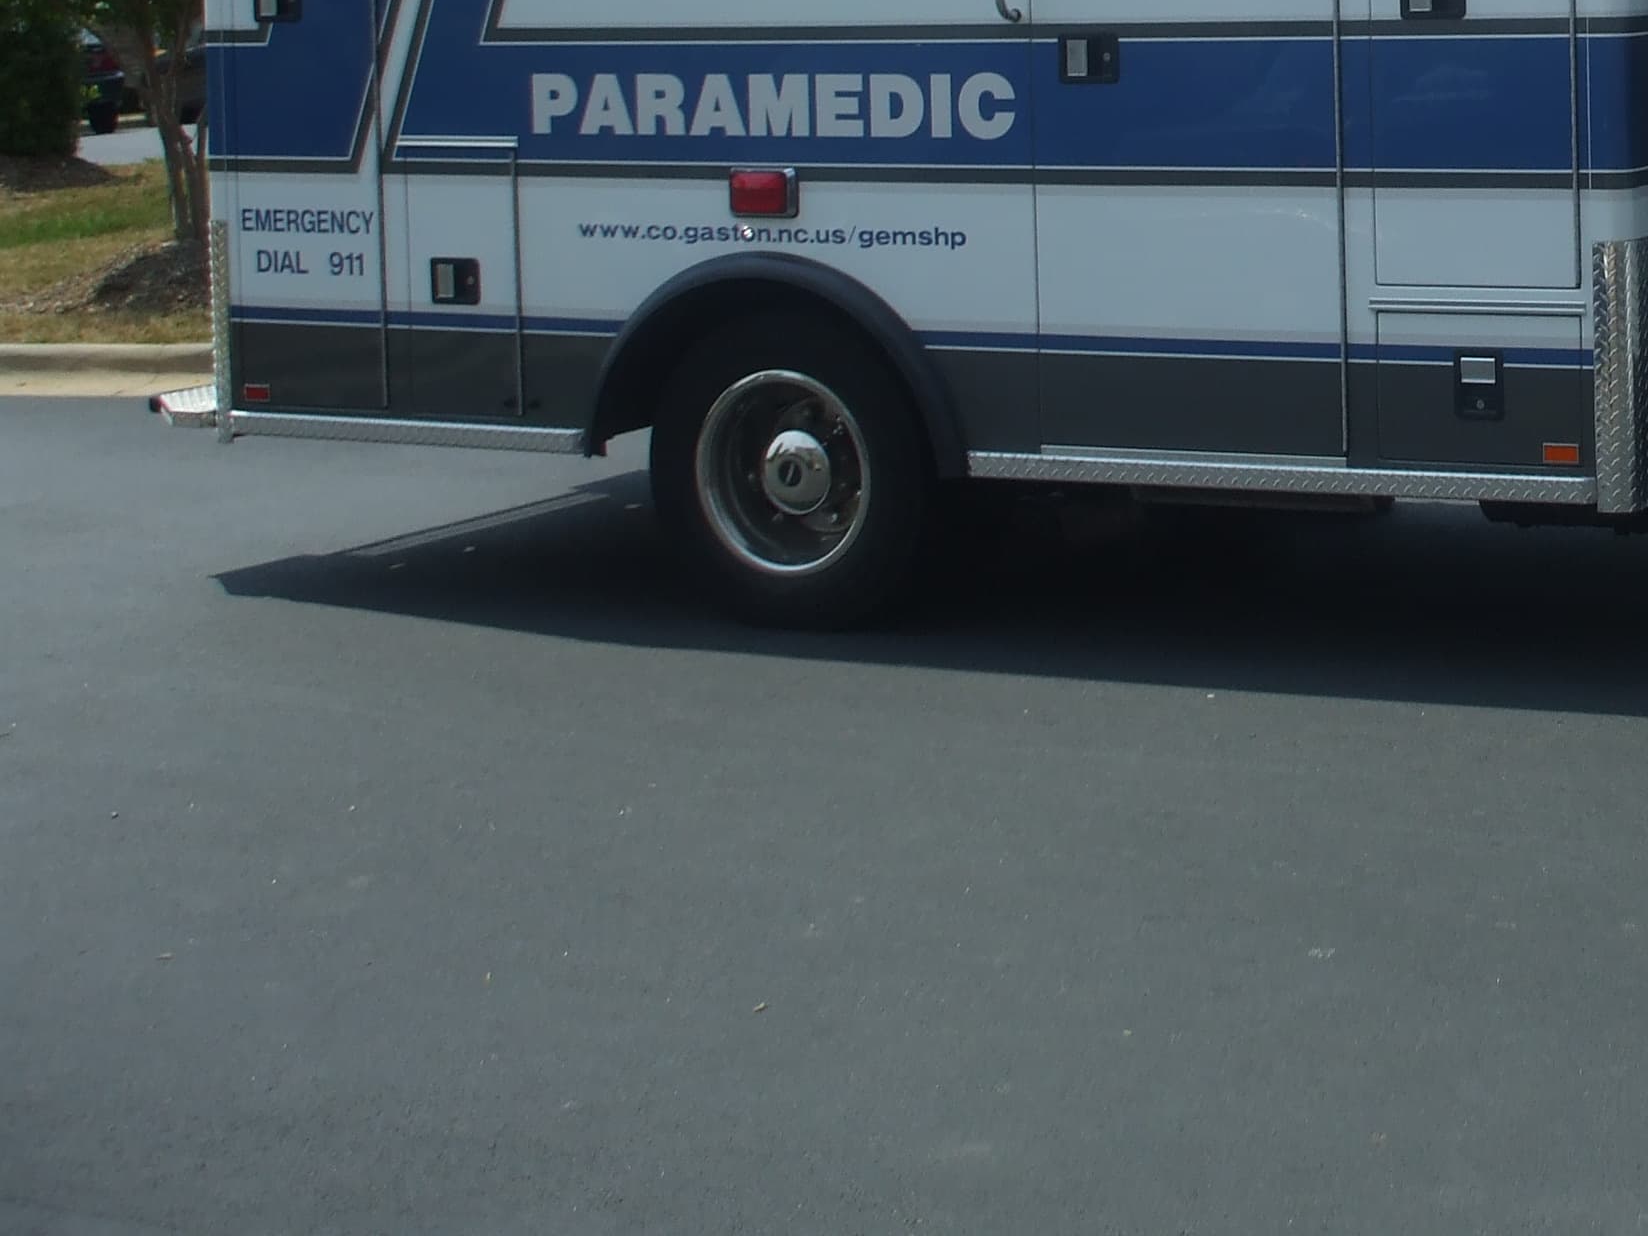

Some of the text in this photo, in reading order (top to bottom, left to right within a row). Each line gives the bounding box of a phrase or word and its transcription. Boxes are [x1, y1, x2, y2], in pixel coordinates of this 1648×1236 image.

[530, 70, 1017, 141] PARAMEDIC
[242, 209, 373, 235] EMERGENCY
[578, 222, 968, 250] www.co.gaston.nc.us/gemshp
[257, 250, 364, 276] DIAL 911
